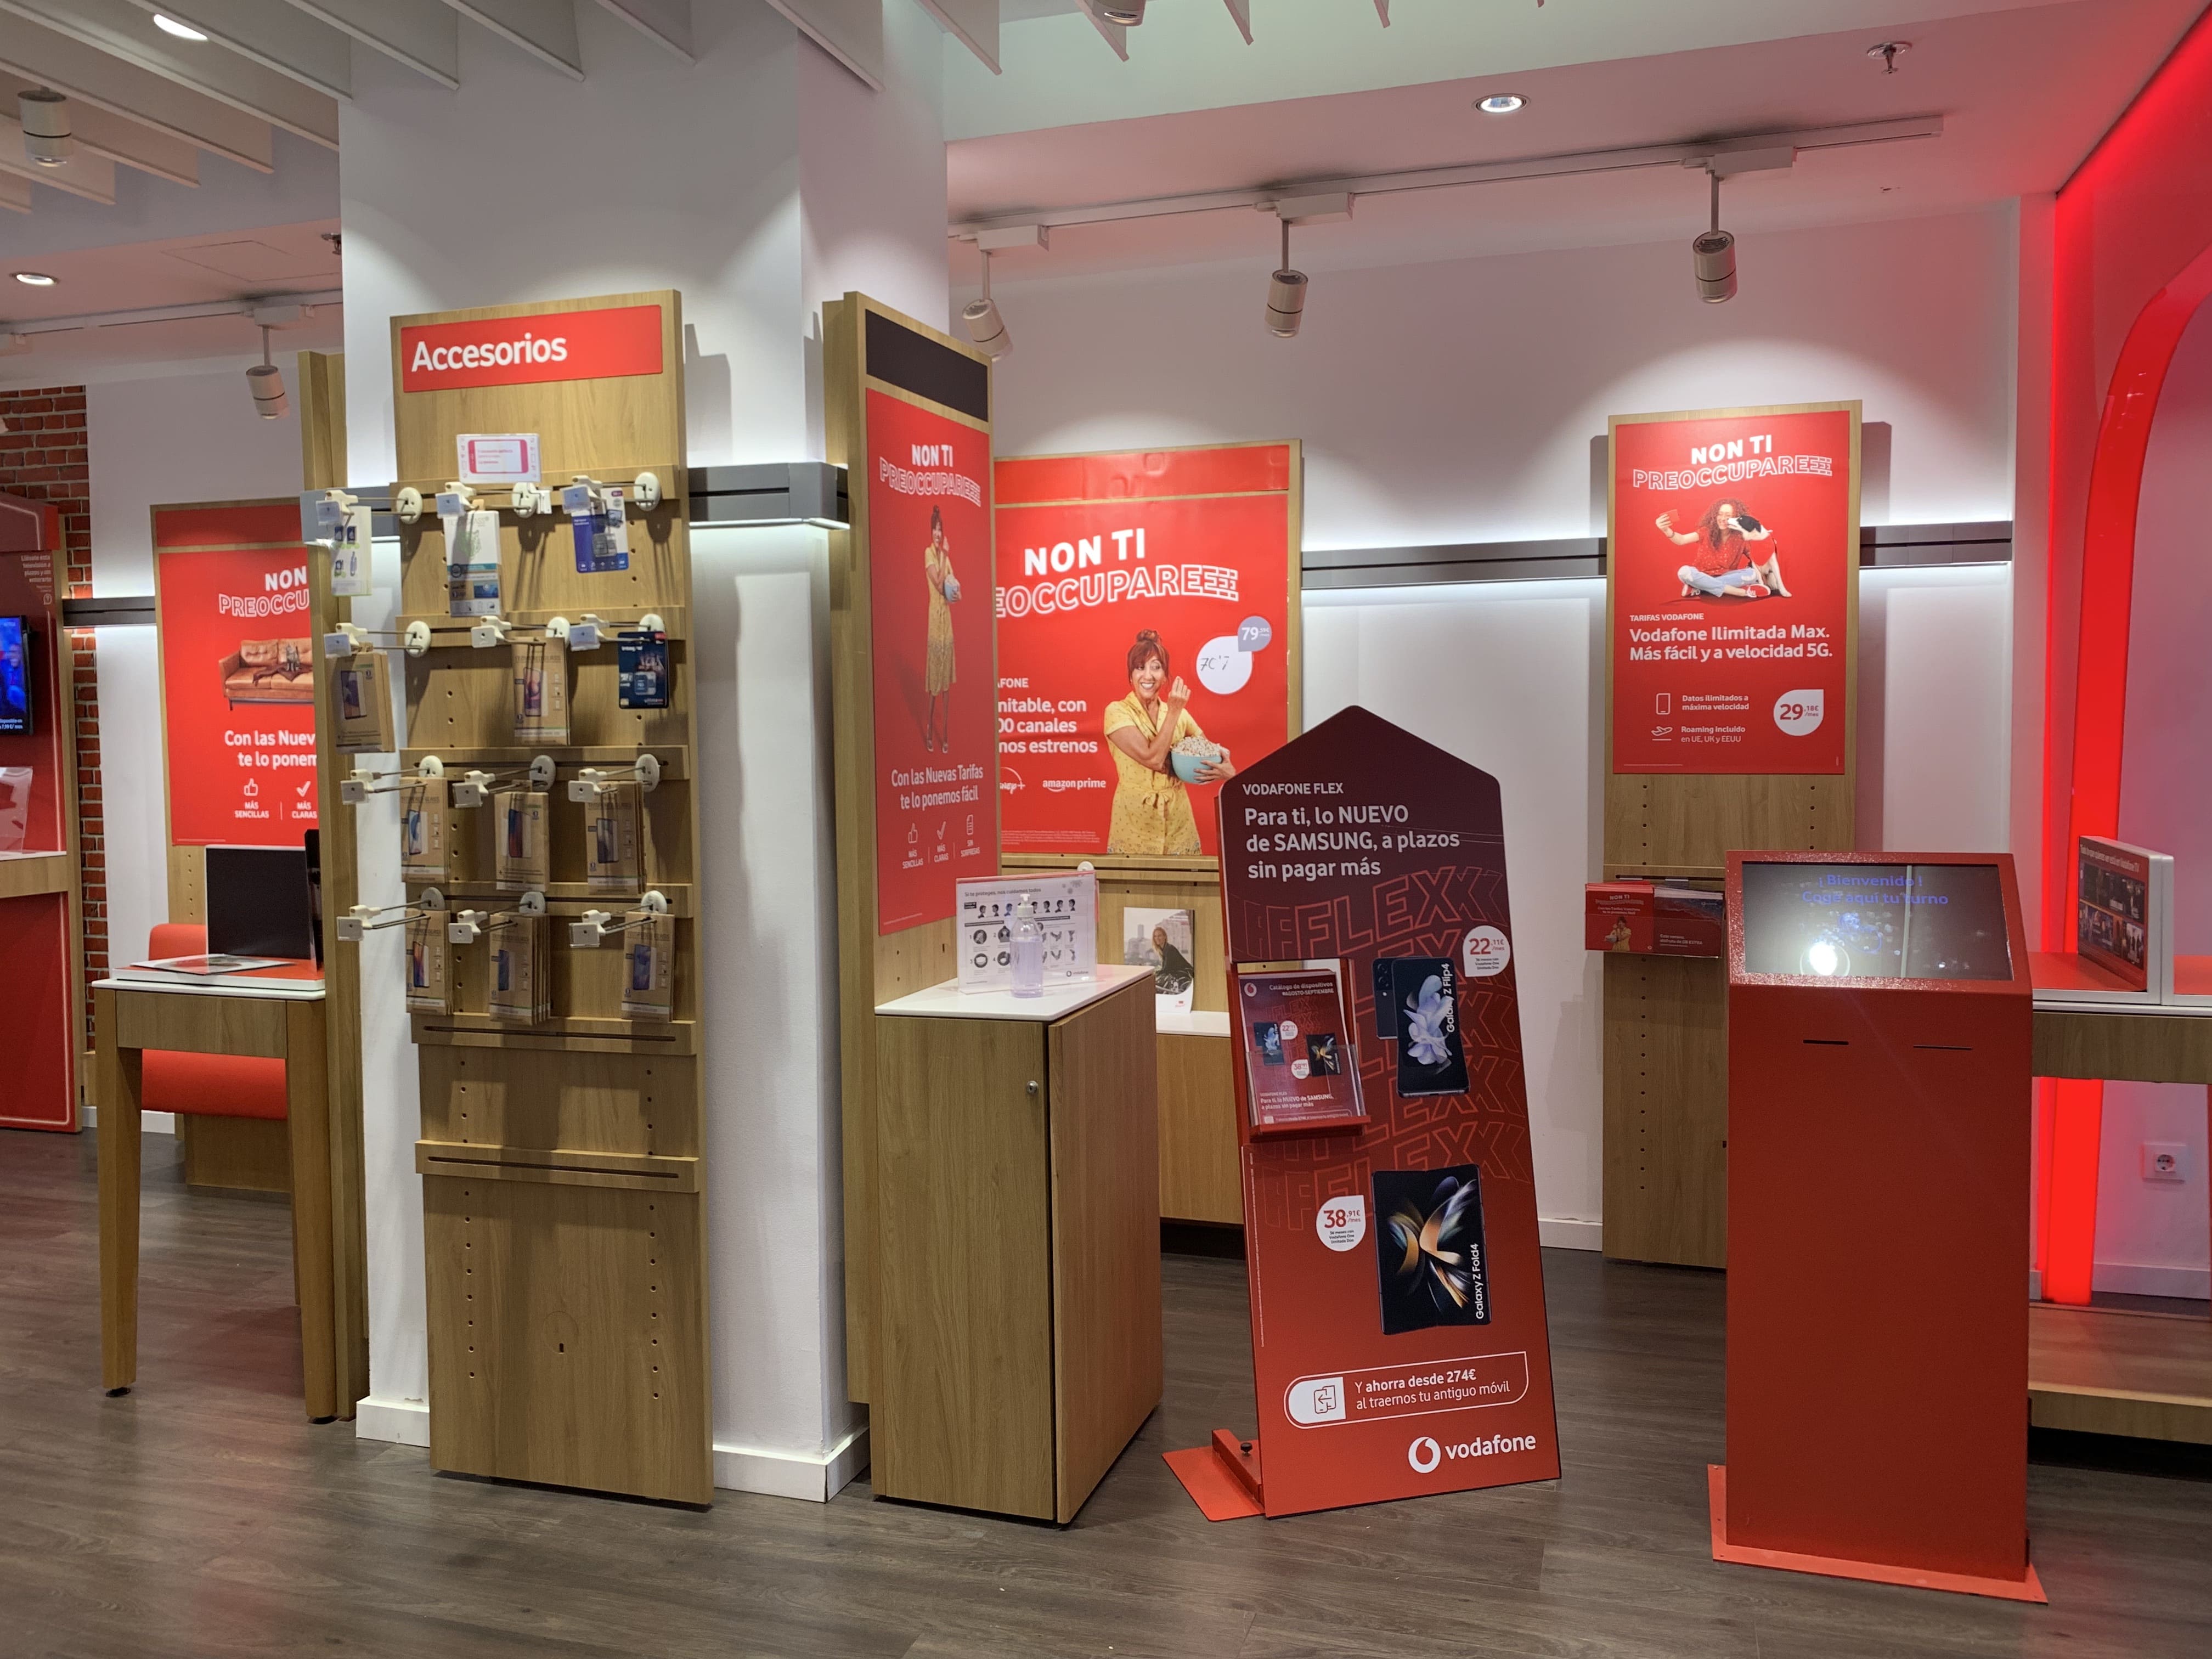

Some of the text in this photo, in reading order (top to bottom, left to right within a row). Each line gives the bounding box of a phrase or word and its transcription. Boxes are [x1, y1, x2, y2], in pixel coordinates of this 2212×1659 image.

[411, 332, 567, 373] Accesorios
[911, 444, 953, 467] NON TI
[1691, 435, 1773, 465] NON TI
[1024, 527, 1146, 576] NON TI
[265, 566, 307, 591] NON
[1629, 613, 1705, 622] TARIFAS VODAFONE
[1629, 624, 1830, 642] Vodafone Ilimitada Max.
[1630, 643, 1833, 663] Más fácil y a velocidad 5G.
[1057, 699, 1087, 712] con
[1705, 694, 1742, 702] ilimitados
[1682, 703, 1749, 712] máxima velocidad
[1017, 718, 1077, 733] canales
[1681, 726, 1714, 735] Roaming
[224, 730, 315, 746] Con las Nuev
[1029, 738, 1098, 753] estrenos
[1691, 735, 1702, 744] UE,
[237, 752, 252, 766] te
[255, 751, 269, 767] lo
[891, 763, 983, 787] Con las Nuevas Tarifas
[1042, 777, 1107, 792] amazon prime
[1242, 782, 1344, 795] VODAFONE FLEX
[244, 800, 259, 810] MÁS
[296, 800, 312, 810] MÁS
[900, 785, 979, 811] te lo ponemos fácil
[234, 810, 269, 819] SENCILLAS
[291, 810, 318, 819] CLARAS
[1244, 805, 1409, 827] Para ti, lo NUEVO
[1246, 831, 1460, 853] de SAMSUNG, a plazos
[1248, 857, 1381, 882] sin pagar más
[1827, 874, 1915, 887] Bienvenido
[1802, 891, 1949, 906] Coge aquí tu turno
[1441, 963, 1453, 986] Flip4
[1470, 1243, 1481, 1272] Fold4
[1475, 1281, 1484, 1319] Galaxy
[1355, 1368, 1477, 1393] Y ahorra desde 274€
[1356, 1380, 1510, 1410] al traernos tu antiguo móvil
[1444, 1434, 1536, 1459] vodafone
